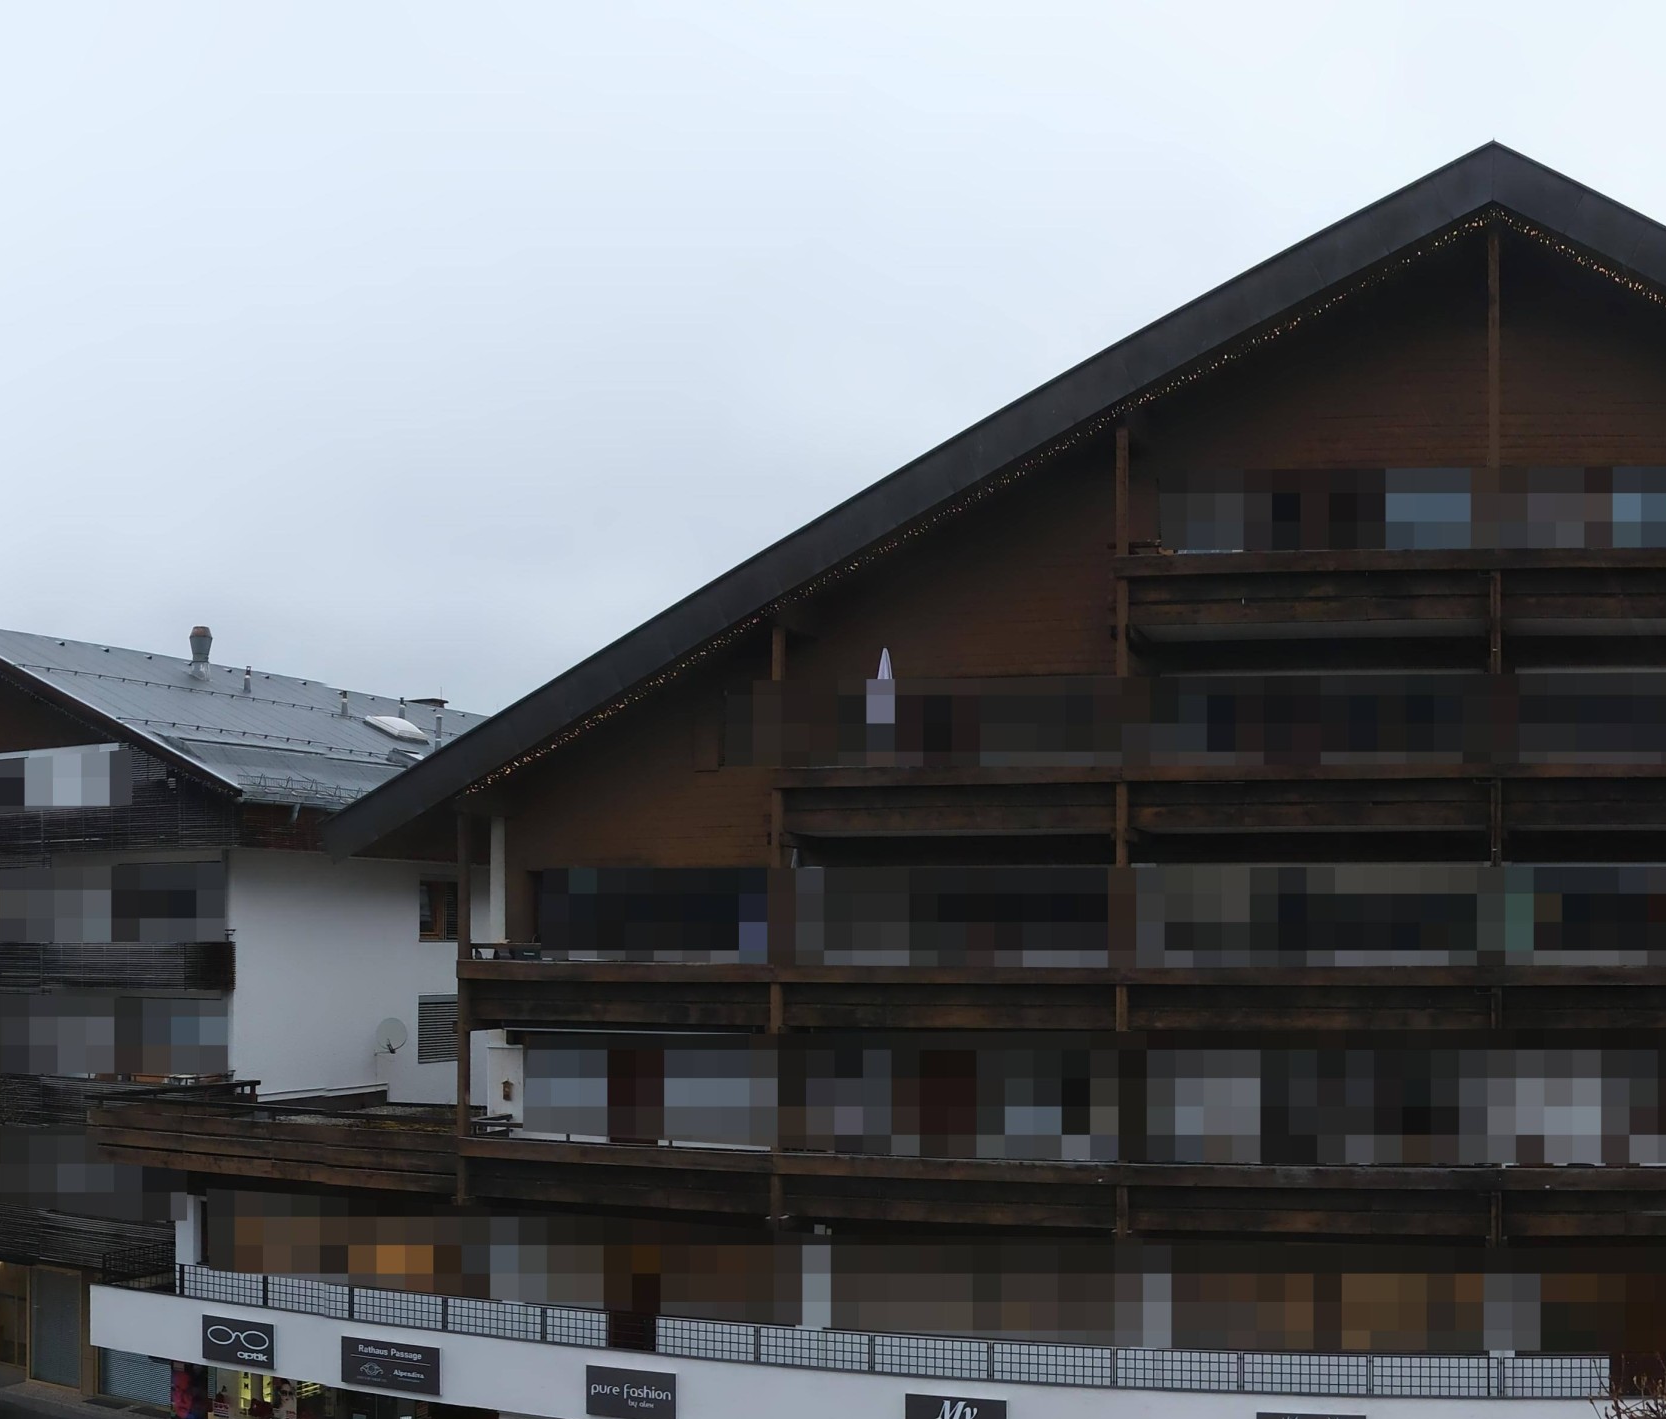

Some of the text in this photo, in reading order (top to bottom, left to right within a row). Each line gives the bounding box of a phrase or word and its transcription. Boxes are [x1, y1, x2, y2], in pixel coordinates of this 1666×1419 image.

[237, 1351, 269, 1363] optik
[358, 1344, 423, 1361] Rathaus Passage
[591, 1383, 672, 1401] pure fashion
[628, 1399, 638, 1409] by
